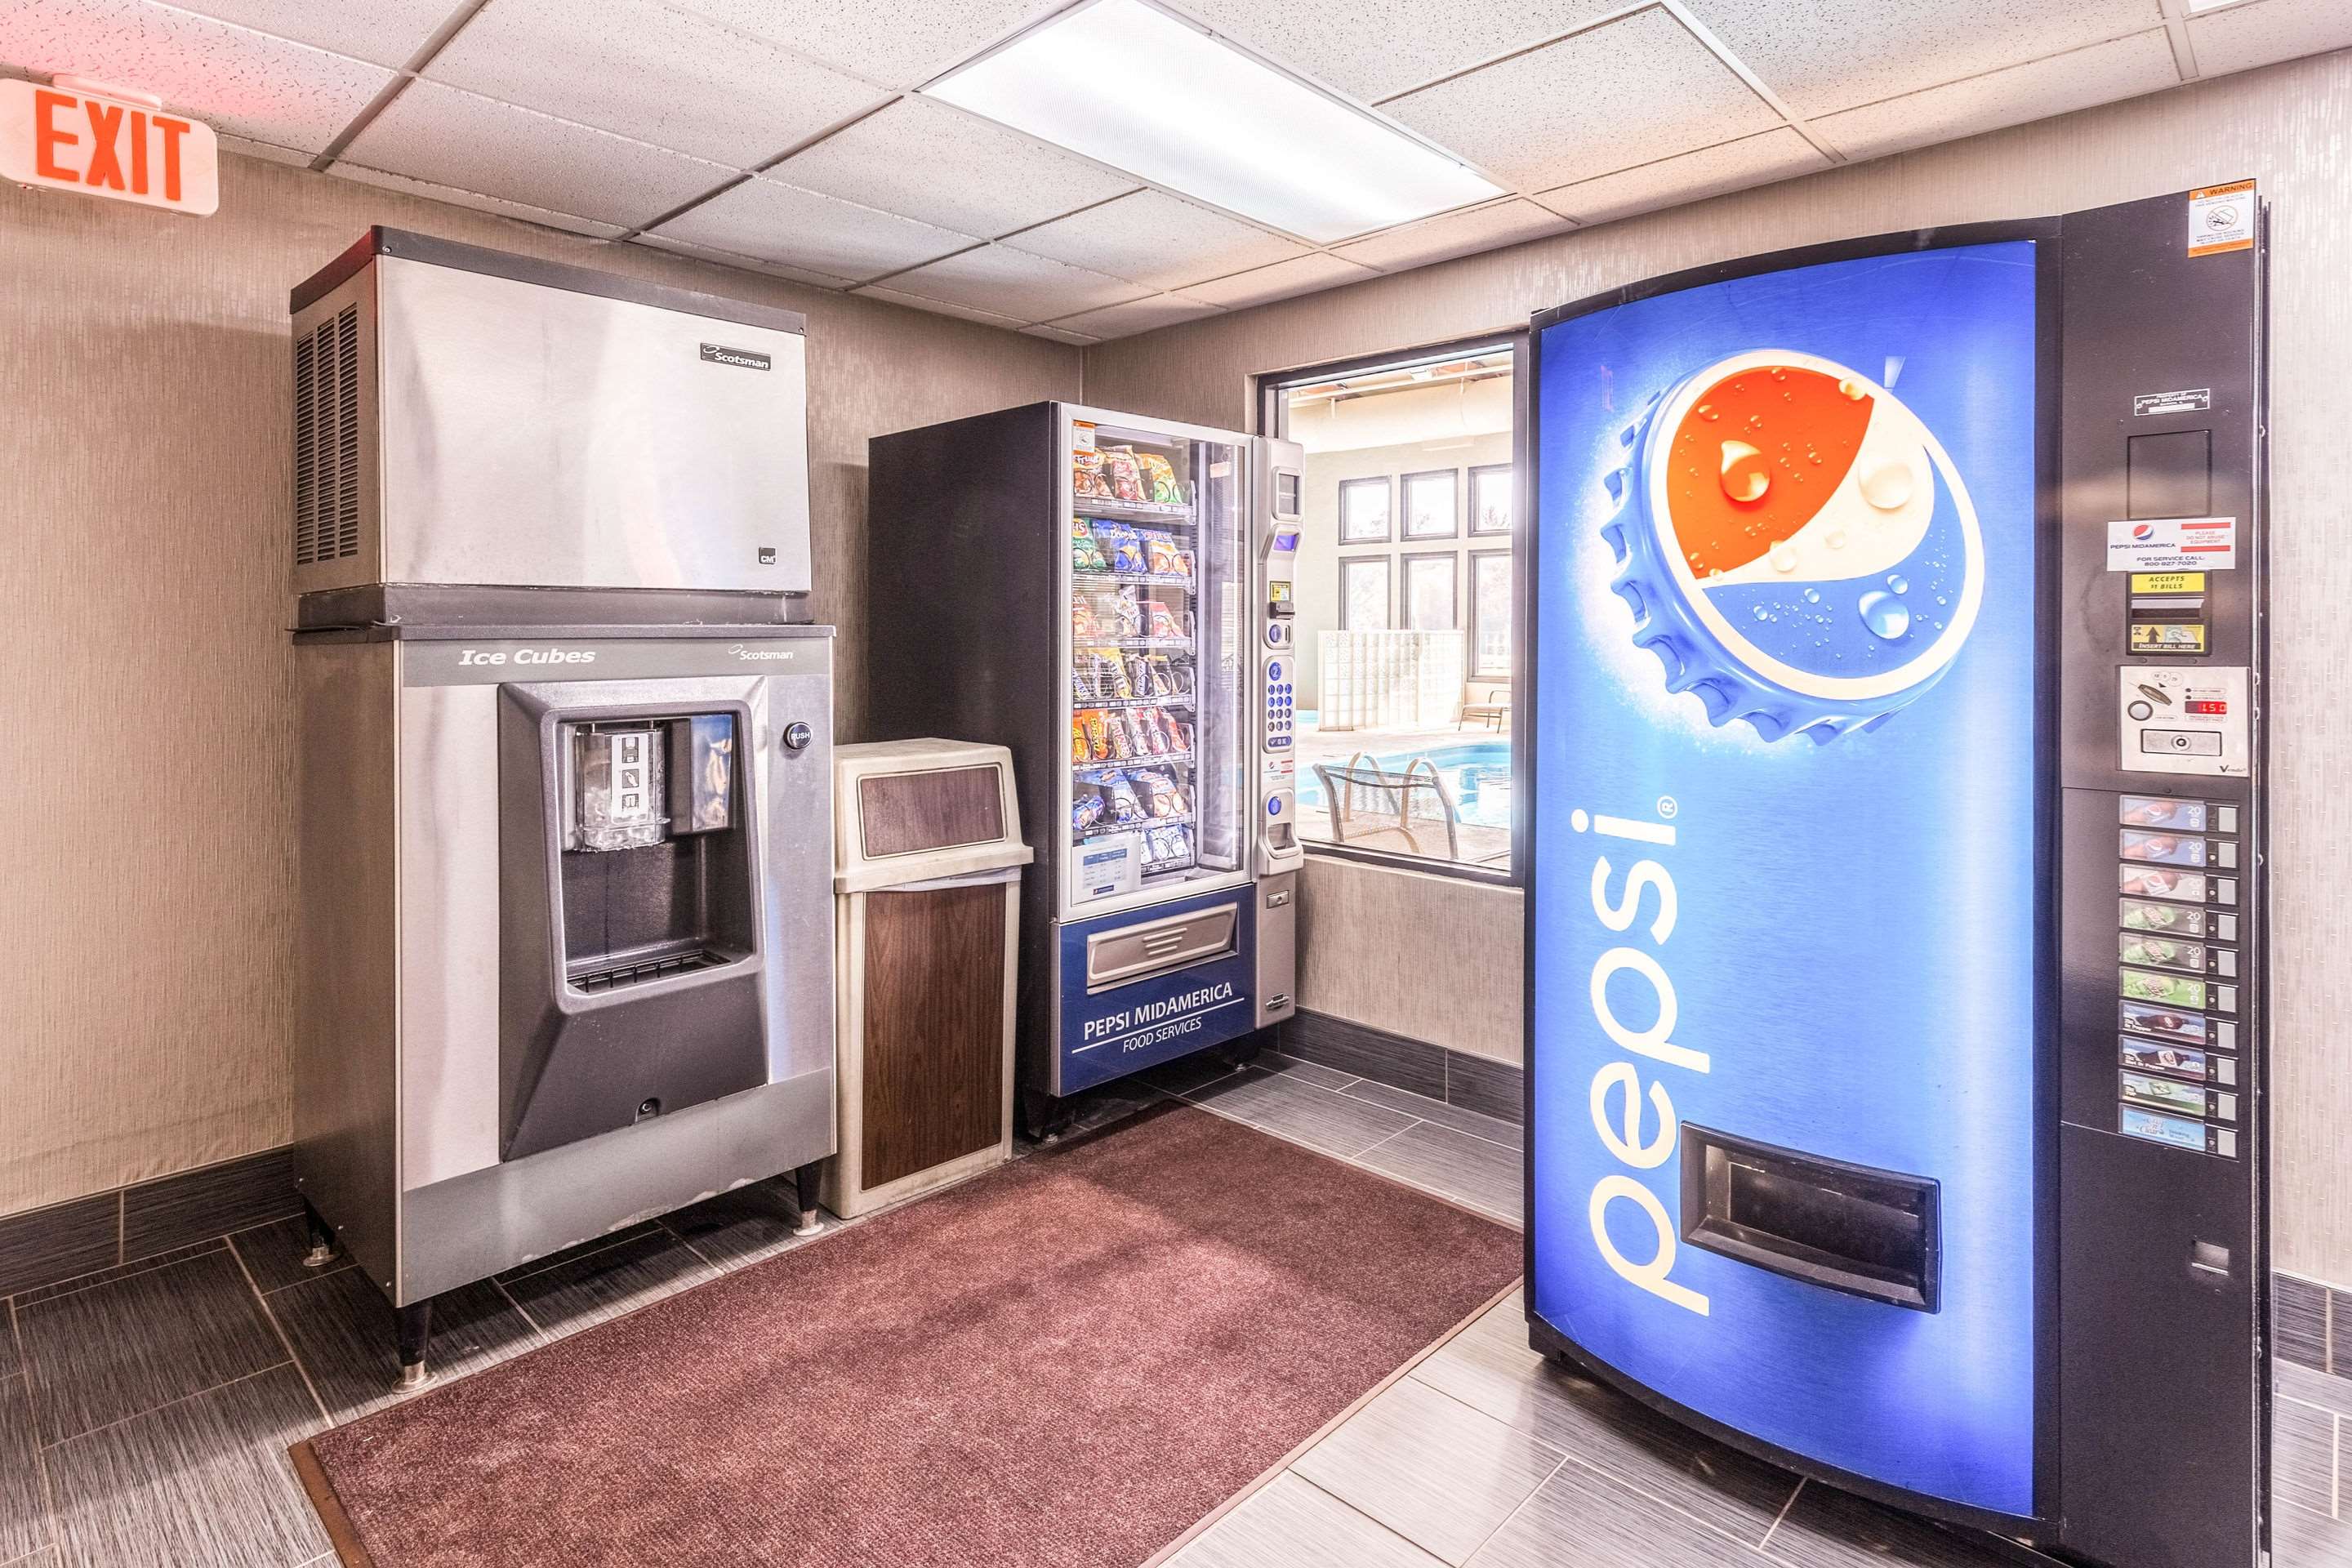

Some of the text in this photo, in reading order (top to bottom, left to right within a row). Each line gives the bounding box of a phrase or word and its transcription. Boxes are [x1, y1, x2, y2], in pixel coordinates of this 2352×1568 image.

[35, 89, 190, 202] EXIT
[2208, 182, 2252, 195] WARNING
[714, 352, 769, 369] Scotsman
[457, 648, 596, 666] Ice Cubes
[739, 649, 794, 662] Scotsman
[791, 732, 810, 740] PUSH
[2188, 805, 2202, 815] 20
[2188, 841, 2203, 850] 20
[2186, 911, 2202, 920] 20
[2186, 946, 2202, 956] 20
[2187, 982, 2201, 992] 20
[1084, 982, 1233, 1040] PEPSI MIDAMERICA
[1123, 1017, 1202, 1054] FOOD SERVICES
[1571, 807, 1711, 1317] pepsi
